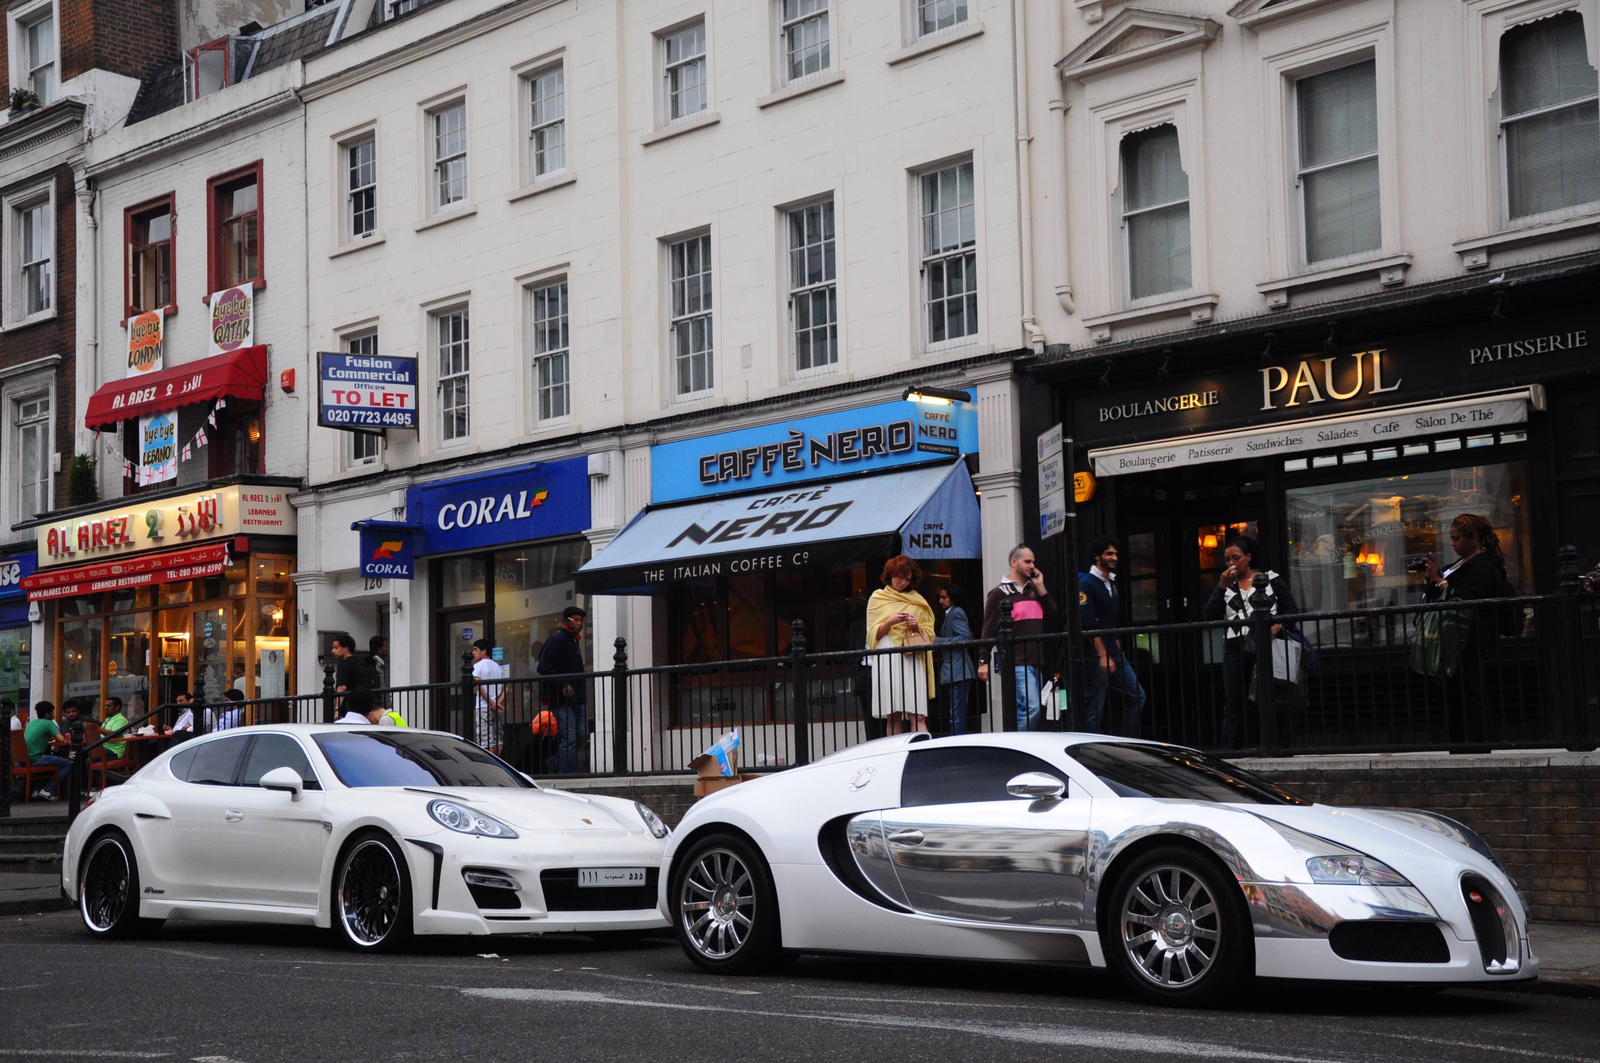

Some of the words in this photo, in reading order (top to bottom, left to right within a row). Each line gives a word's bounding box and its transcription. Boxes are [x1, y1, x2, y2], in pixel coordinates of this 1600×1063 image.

[213, 300, 231, 322] bye
[233, 295, 251, 316] bye
[131, 321, 146, 343] bye
[214, 318, 250, 344] QATAR
[1470, 330, 1588, 365] PATISSERIE
[328, 367, 409, 382] Commercial
[345, 356, 392, 369] Fusion
[1258, 349, 1402, 411] PAUL
[112, 394, 125, 409] AL
[128, 386, 157, 406] AREZ
[332, 390, 361, 405] TO
[370, 392, 408, 408] LET
[1099, 390, 1219, 422] BOULANGERIE
[328, 410, 350, 422] 020
[352, 410, 380, 423] 7723
[383, 412, 411, 424] 4495
[144, 426, 158, 445] bye
[160, 422, 174, 441] bye
[918, 424, 957, 440] NERO
[1120, 452, 1176, 469] Boulangerie
[1188, 445, 1233, 459] Patisserie
[1246, 436, 1303, 452] Sandwiches
[1317, 428, 1358, 442] Salades
[1373, 421, 1400, 435] Café
[1416, 416, 1446, 429] Salon
[1451, 413, 1466, 424] De
[1470, 408, 1494, 422] Thé
[699, 429, 805, 484] CAFFÈ
[810, 419, 914, 467] NERO
[250, 494, 264, 502] AREZ
[438, 490, 531, 530] CORAL
[747, 486, 832, 510] CAFFÈ
[47, 526, 75, 555] AL
[78, 514, 133, 550] AREZ
[665, 500, 854, 549] NERO
[909, 533, 952, 548] NERO
[366, 563, 408, 574] CORAL
[644, 570, 664, 582] THE
[674, 562, 720, 579] ITALIAN
[731, 555, 782, 573] COFFEE
[30, 585, 78, 599] WWW.ALAREZ.CO.UK
[92, 579, 116, 590] LEBANESE
[118, 574, 152, 586] RESTAURANT
[179, 569, 190, 577] 020
